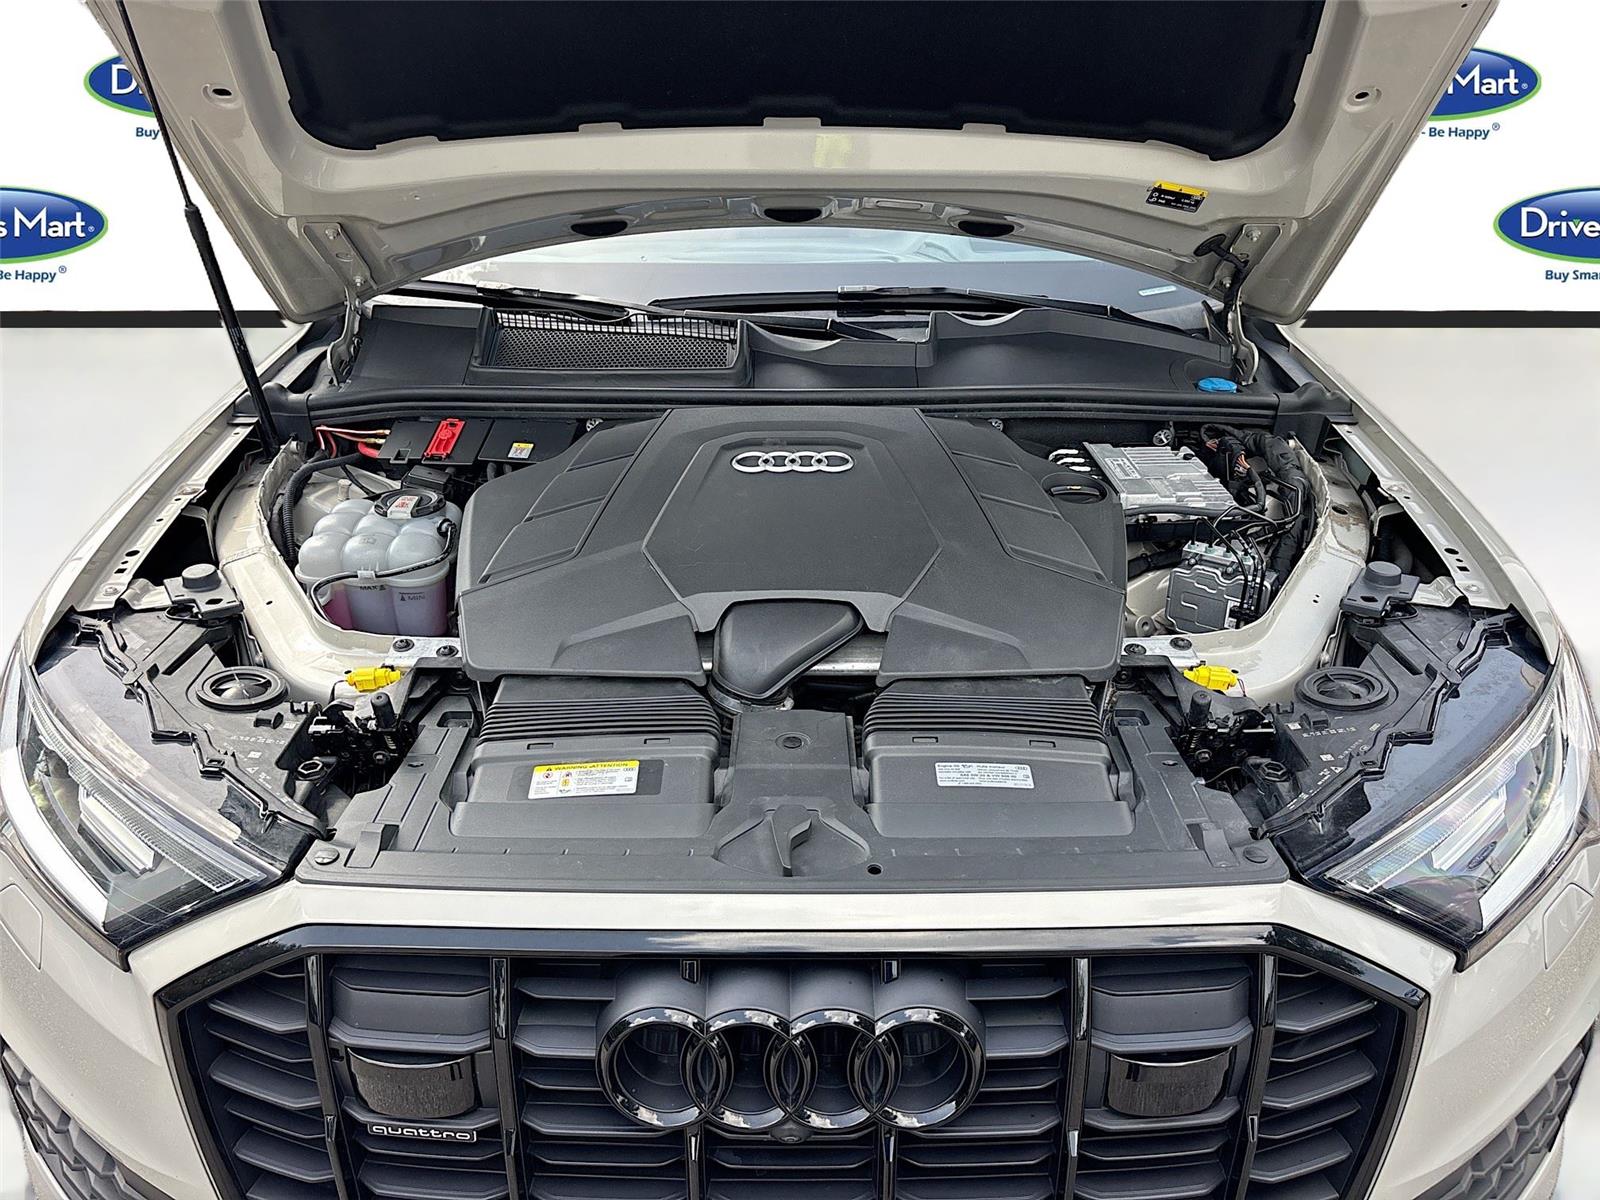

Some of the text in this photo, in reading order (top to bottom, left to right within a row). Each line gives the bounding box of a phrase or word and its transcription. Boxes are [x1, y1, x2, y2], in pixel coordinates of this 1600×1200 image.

[135, 126, 160, 140] Buy
[1428, 126, 1445, 138] Be
[1545, 269, 1570, 283] Buy
[372, 1126, 471, 1140] quattro
